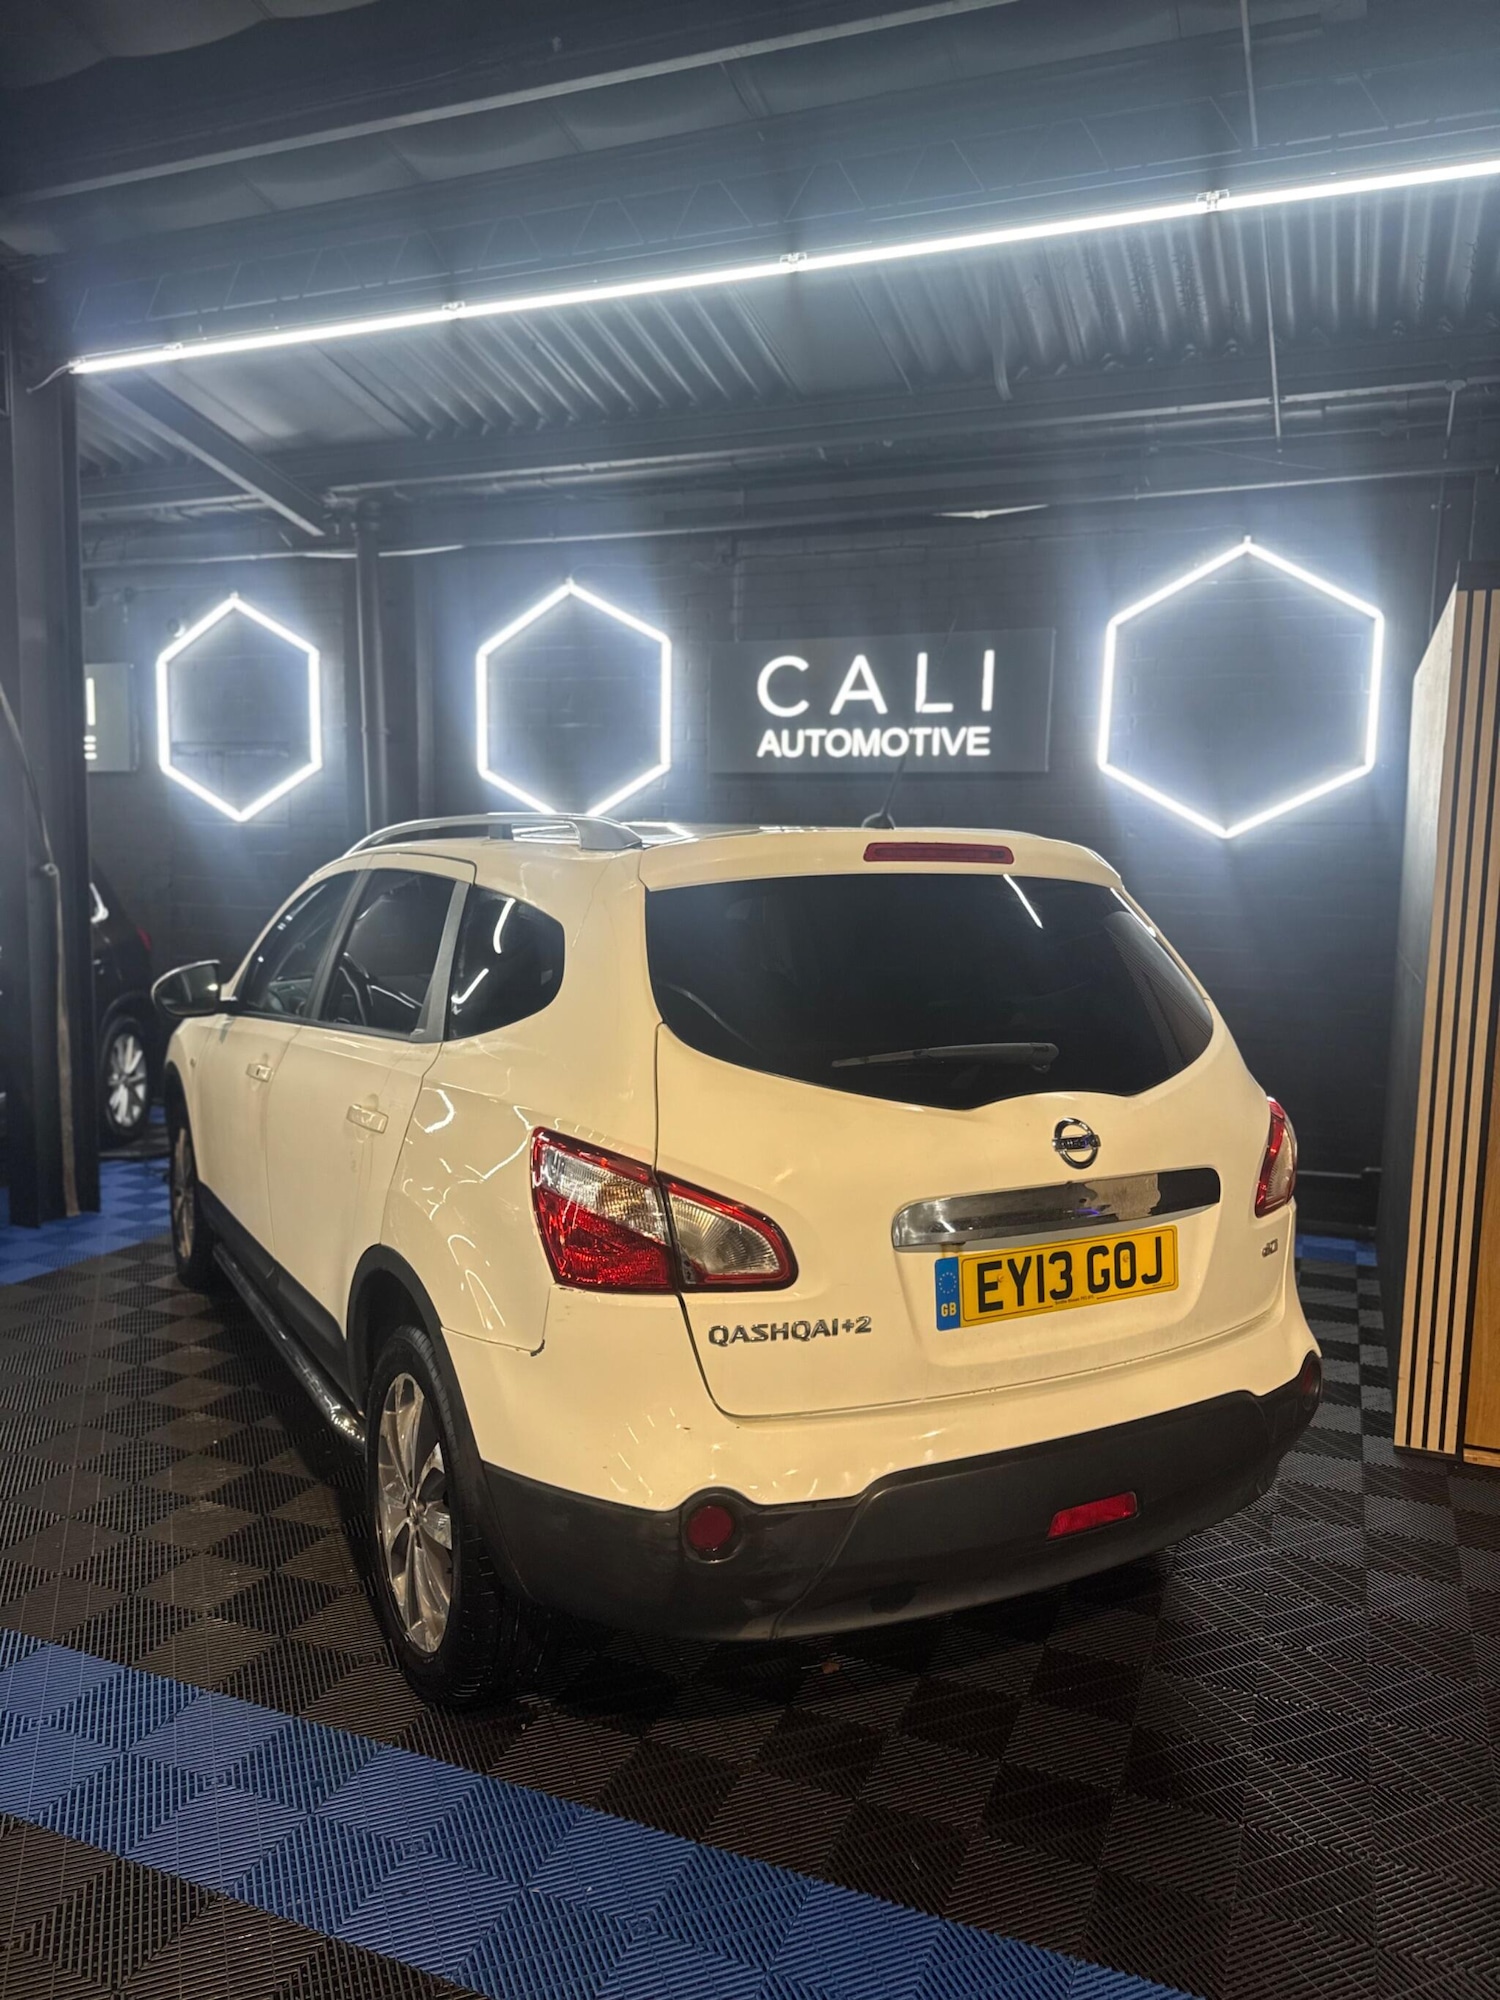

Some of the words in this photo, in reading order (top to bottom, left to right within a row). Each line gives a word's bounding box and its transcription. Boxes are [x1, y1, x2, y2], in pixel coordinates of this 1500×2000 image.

[757, 649, 995, 717] CALI
[757, 726, 991, 758] AUTOMOTIVE
[977, 1251, 1073, 1313] EY13
[1086, 1236, 1162, 1294] GOJ
[941, 1302, 957, 1318] GB
[708, 1316, 872, 1347] QASHQAI+2
